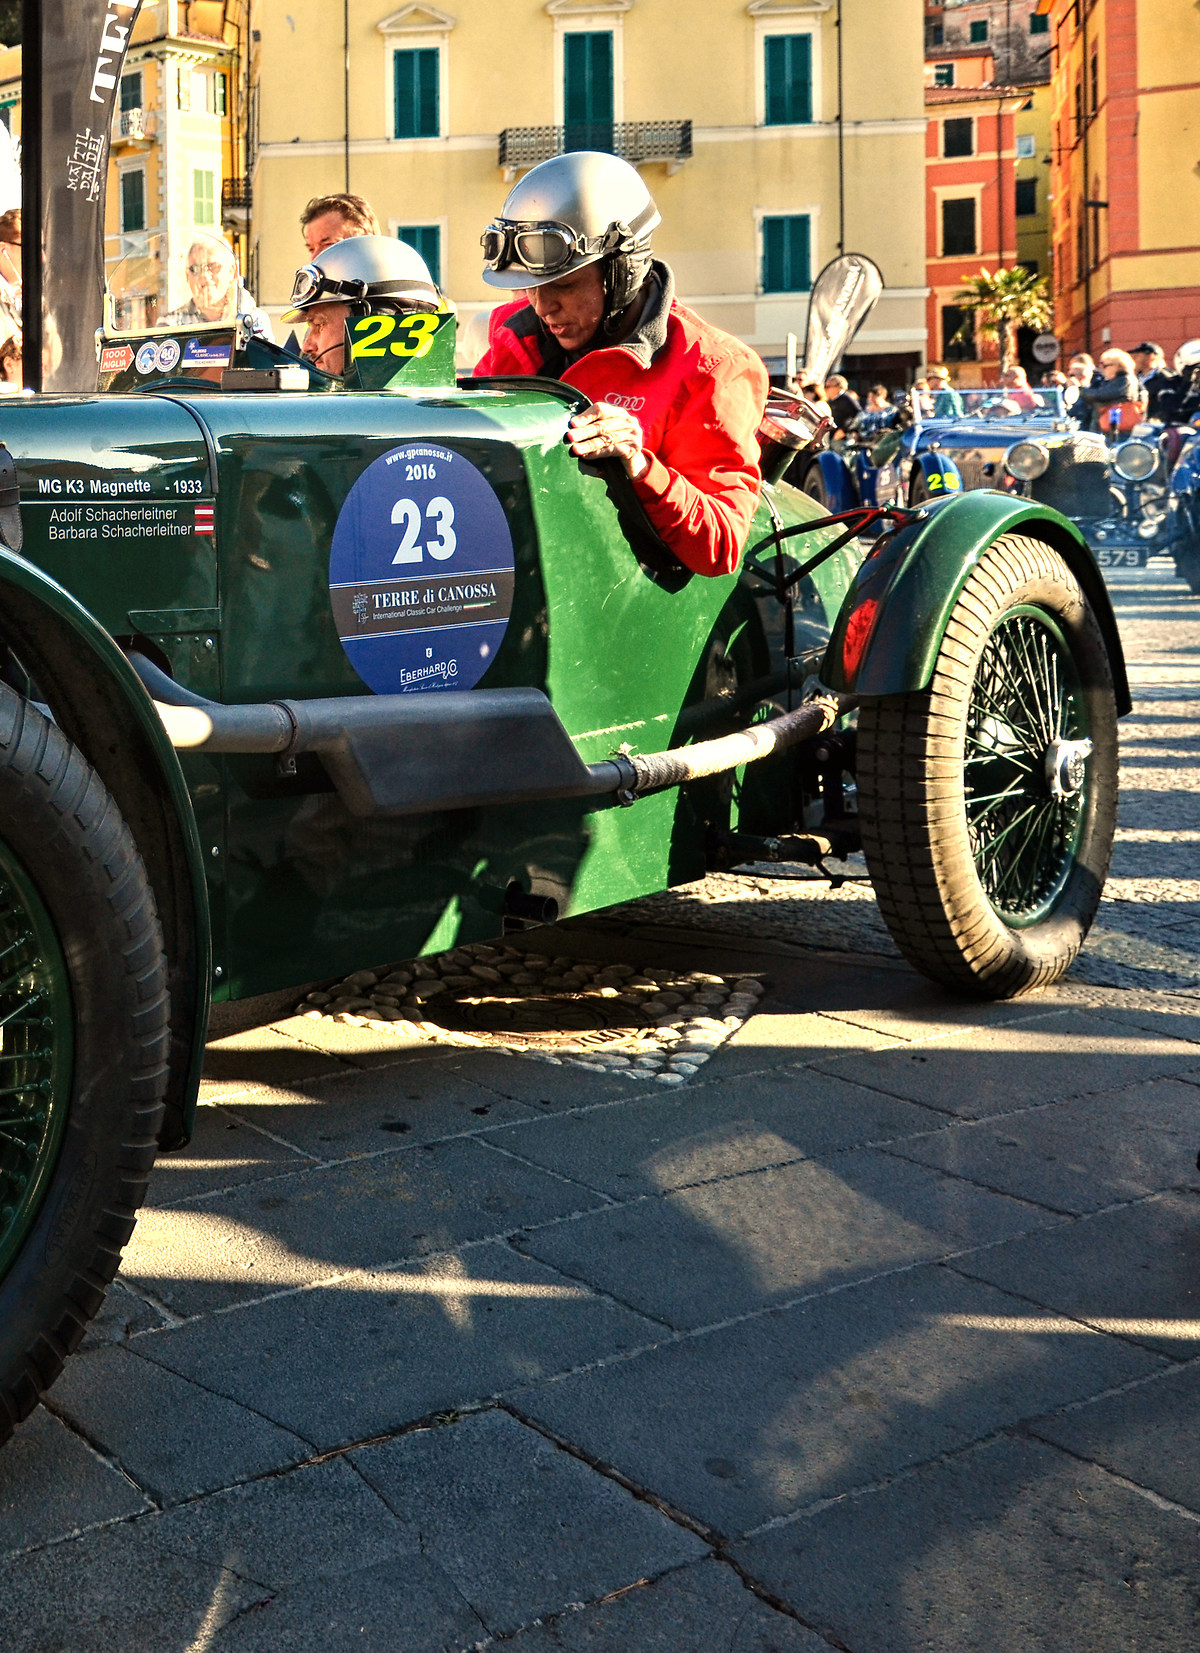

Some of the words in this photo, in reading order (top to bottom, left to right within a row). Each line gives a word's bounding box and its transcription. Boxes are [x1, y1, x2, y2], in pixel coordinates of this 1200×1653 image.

[90, 0, 140, 103] TE
[351, 313, 440, 360] 23
[105, 349, 126, 359] 1000
[102, 359, 127, 369] MIGLIA
[385, 448, 453, 466] www.gpcanossa.it
[405, 463, 436, 481] 2016
[38, 479, 62, 494] MG
[66, 479, 85, 494] K3
[90, 479, 151, 497] Magnette
[173, 480, 203, 494] 1933
[50, 508, 82, 523] Adolf
[85, 507, 177, 522] Schacherleitner
[49, 524, 98, 540] Barbara
[101, 523, 192, 538] Schacherleitner
[391, 496, 457, 565] 23
[1097, 550, 1139, 566] 579
[372, 589, 419, 609] TERRE
[423, 589, 434, 604] di
[438, 582, 497, 602] CANOSSA
[372, 609, 406, 620] International
[406, 607, 426, 617] Classic
[426, 606, 436, 615] Car
[436, 604, 462, 614] Challenge
[400, 662, 447, 683] EBERHARD
